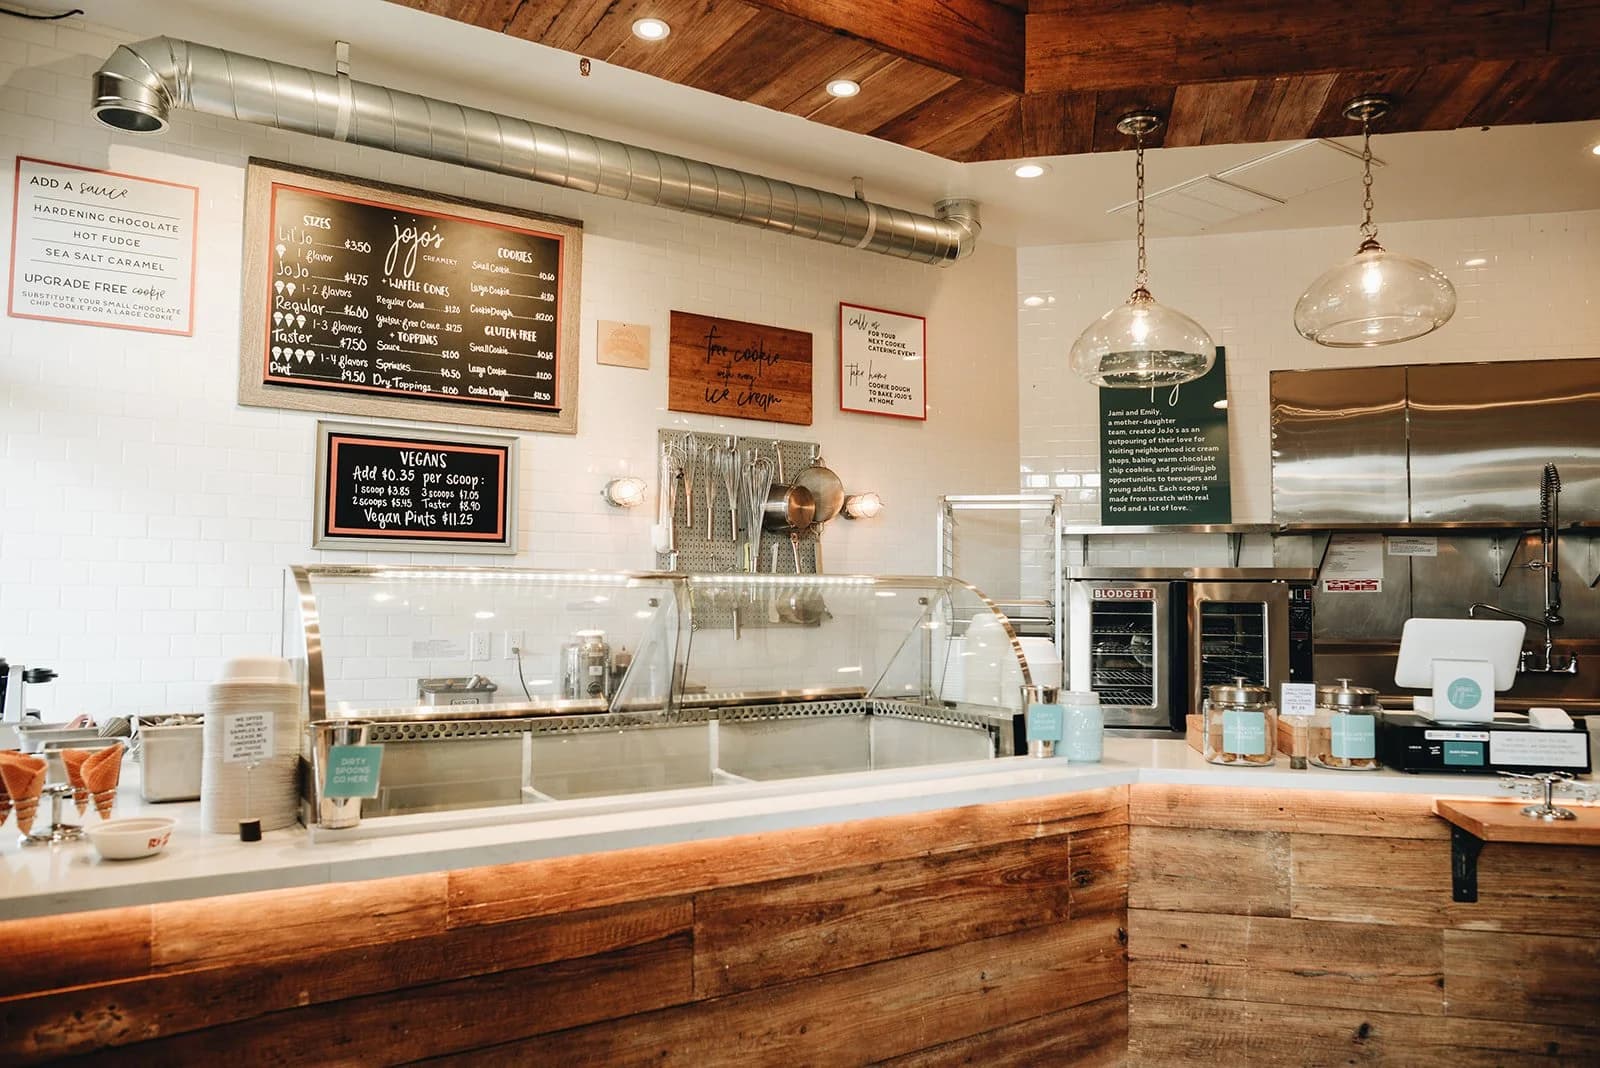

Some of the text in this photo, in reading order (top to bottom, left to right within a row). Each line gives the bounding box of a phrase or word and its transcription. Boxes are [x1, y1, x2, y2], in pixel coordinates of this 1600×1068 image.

[30, 176, 128, 199] ADD A sauce
[34, 204, 179, 232] HARDENING CHOCOLATE
[303, 215, 331, 229] SIZES
[73, 231, 141, 247] HOT FUDGE
[299, 232, 312, 245] Jo
[385, 216, 444, 278] jojo's
[45, 248, 165, 271] SEA SALT CARAMEL
[306, 250, 333, 263] flavor
[422, 254, 458, 267] CREAMERY
[497, 247, 533, 264] COOKIES
[24, 273, 166, 300] UPGRADE FREE cookie
[321, 285, 352, 300] flavors
[389, 278, 450, 298] WAFFLE CONES
[22, 290, 181, 315] SUBSTITUTE YOUR SMALL CHOCOLATE
[275, 295, 325, 316] Regular
[376, 295, 405, 309] Regular
[53, 302, 84, 311] COOKIE
[114, 309, 141, 317] LARGE
[143, 312, 173, 320] COOKIE
[331, 320, 362, 335] flavors
[849, 313, 868, 330] call
[272, 328, 312, 344] Taster
[397, 331, 439, 346] TOPPINGS
[484, 325, 537, 342] GLUTEN-FREE
[376, 340, 400, 351] Sauce
[704, 325, 780, 377] free cookie
[868, 345, 897, 355] CATERING
[885, 340, 906, 349] COOKIE
[338, 354, 369, 369] flavors
[269, 361, 366, 384] Pint $9.50
[868, 360, 887, 381] home
[373, 373, 432, 393] Dry Toppings
[868, 382, 889, 390] COOKIE
[705, 381, 782, 411] ice cream
[1107, 409, 1124, 417] Jami
[1113, 418, 1176, 428] mother-daughter
[1108, 437, 1147, 447] outpouring
[1108, 447, 1134, 456] visiting
[1135, 446, 1184, 455] neighborhood
[400, 450, 448, 468] VEGANS
[1132, 456, 1157, 465] baking
[1108, 466, 1124, 475] chip
[1171, 465, 1204, 474] providing
[1205, 465, 1216, 473] job
[352, 466, 485, 489] Add $0.35 per scoop:
[1108, 475, 1156, 485] opportunities
[1167, 475, 1202, 484] teenagers
[361, 485, 384, 496] scoop
[388, 485, 410, 496] $3.85
[429, 489, 455, 499] scoops
[1108, 486, 1131, 495] young
[359, 498, 387, 508] scoops
[421, 498, 451, 509] Taster
[1148, 494, 1176, 502] scratch
[364, 507, 474, 529] Vegan Pints $11.25
[1095, 590, 1152, 598] BLODGETT
[340, 757, 367, 766] DIRTY
[335, 766, 371, 775] SPOONS
[332, 775, 369, 784] GO HERE
